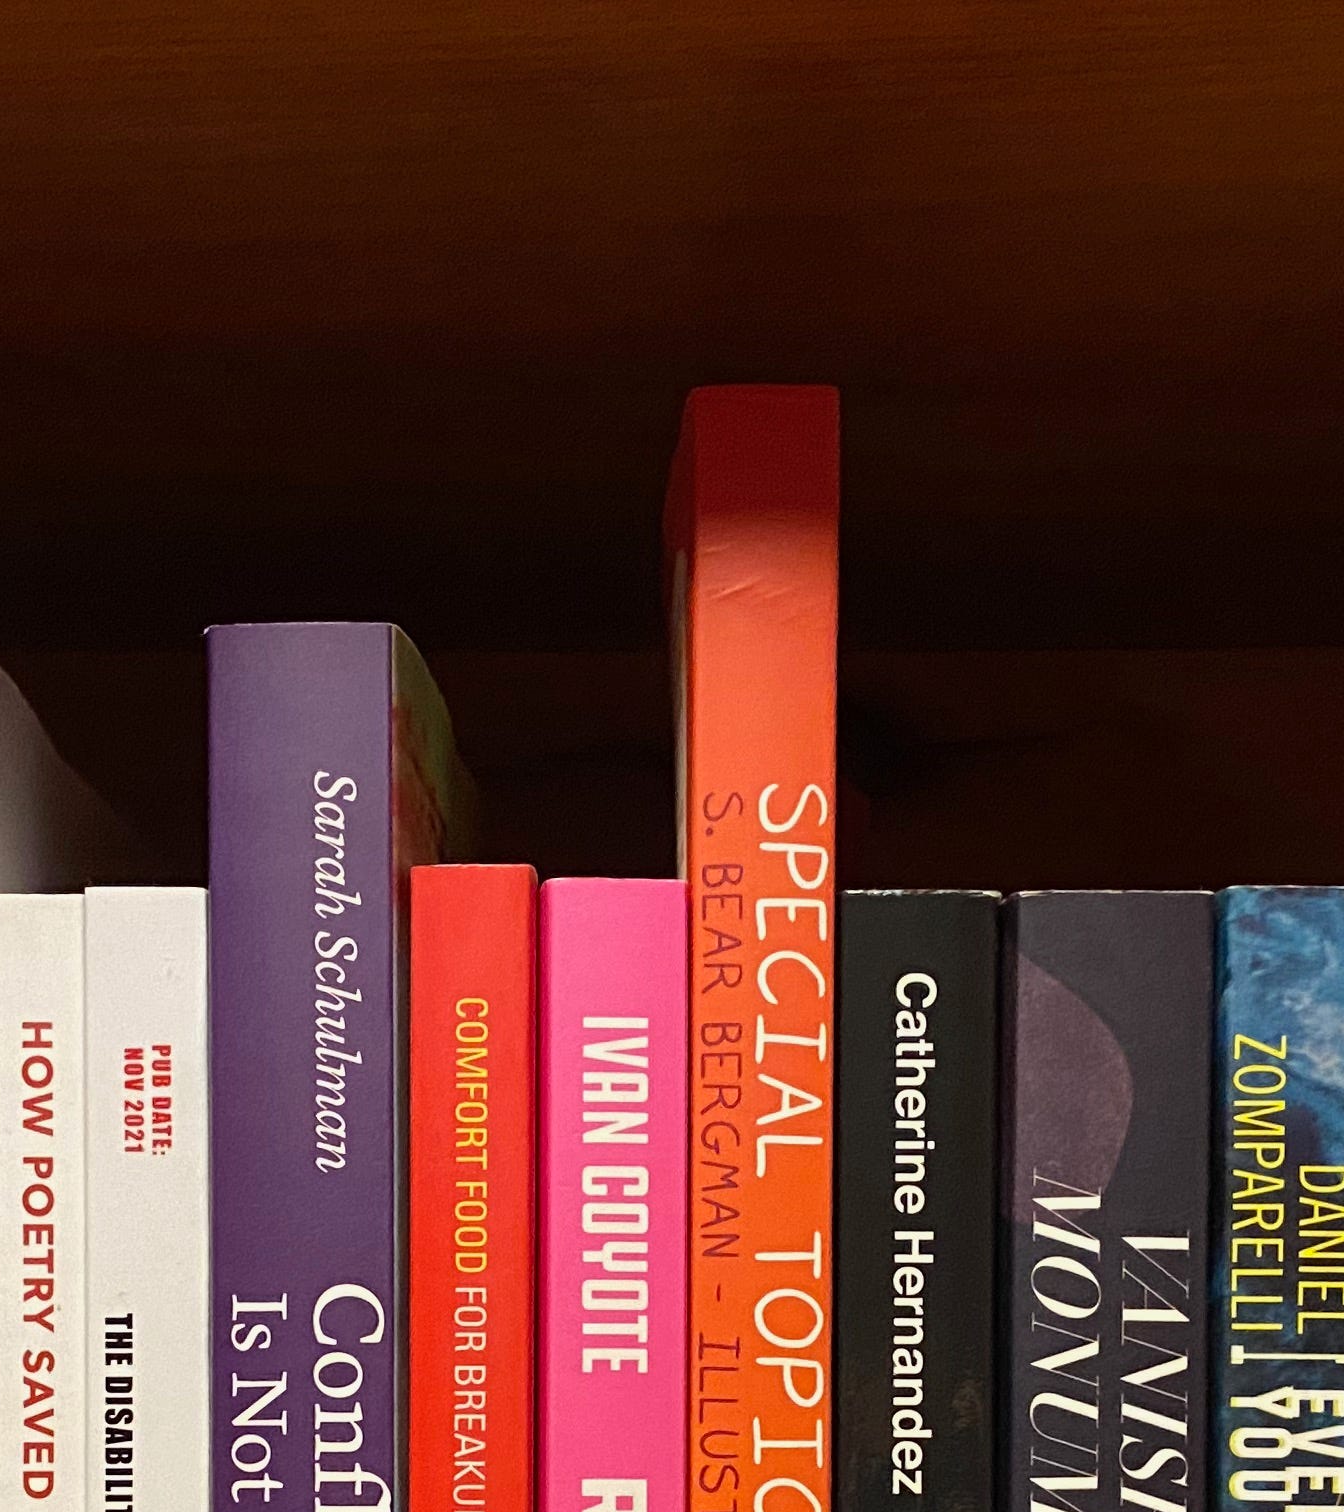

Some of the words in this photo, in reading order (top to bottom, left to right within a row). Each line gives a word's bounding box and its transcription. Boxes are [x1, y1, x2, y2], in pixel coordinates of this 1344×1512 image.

[310, 771, 359, 917] Sarah
[310, 932, 359, 1172] Schulman
[754, 784, 828, 1179] SPECIAL
[21, 1021, 54, 1134] HOW
[451, 997, 490, 1169] COMFORT
[580, 1015, 648, 1142] IVAN
[893, 972, 937, 1213] Catherine
[20, 1157, 55, 1332] POETRY
[451, 1180, 490, 1273] FOOD
[1231, 1034, 1286, 1331] ZOMPARELLI
[228, 1294, 287, 1356] Is
[451, 1285, 490, 1352] FOR
[580, 1165, 648, 1372] COYOTE
[20, 1350, 55, 1500] SAVED
[228, 1373, 287, 1498] Not
[893, 1229, 937, 1494] Hernandez
